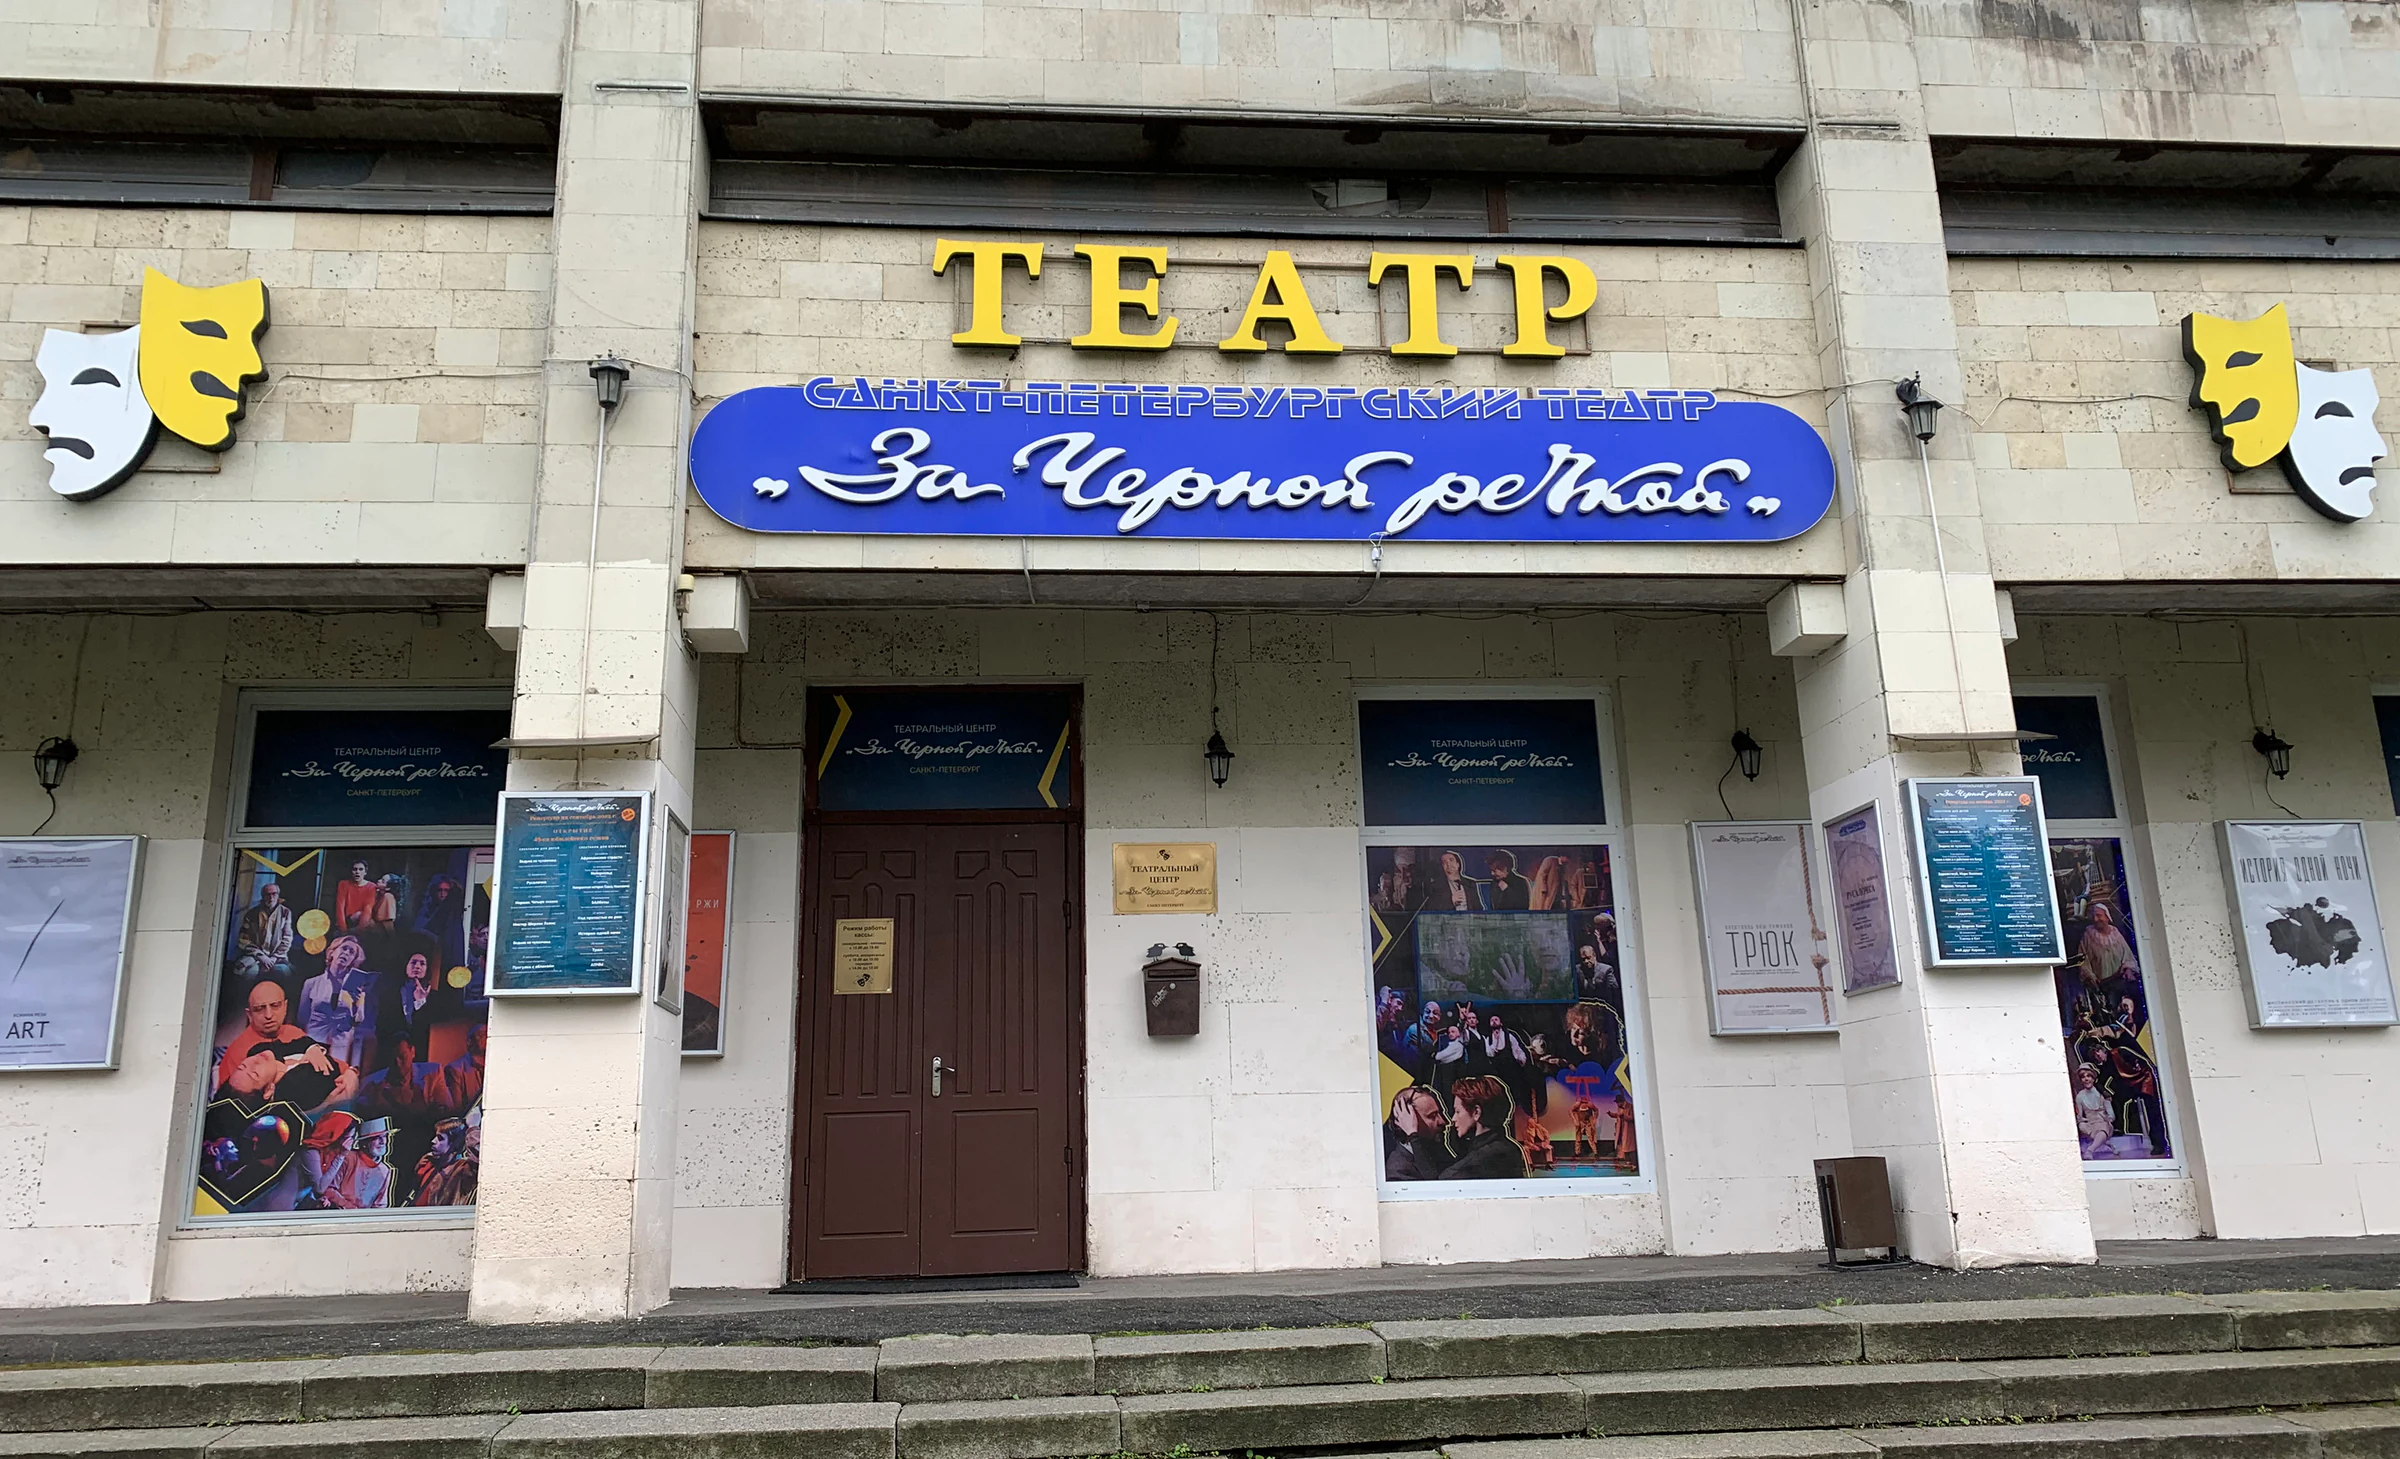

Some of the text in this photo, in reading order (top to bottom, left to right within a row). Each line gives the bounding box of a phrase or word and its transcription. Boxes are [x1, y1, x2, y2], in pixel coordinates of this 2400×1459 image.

[932, 238, 1598, 360] ТЕАТР
[1538, 387, 1718, 421] ТЕАТР
[1012, 430, 1414, 534] Черной
[893, 722, 997, 735] ТЕАТРАЛЬНЫЙ ЦЕНТР
[333, 745, 442, 757] ТЕАТРАЛЬНЫЙ ЦЕНТР
[894, 738, 973, 760] Черной
[1430, 738, 1528, 749] ТЕАТРАЛЬНЫЙ ЦЕНТР
[332, 760, 415, 783] Черной
[909, 765, 982, 775] САНКТ-ПЕТЕРБУРГ
[1432, 752, 1506, 772] Черной
[1447, 777, 1516, 786] САНКТ-ПЕТЕРБУРГ
[346, 788, 423, 797] САНКТ-ПЕТЕРБУРГ
[1130, 864, 1199, 873] ТЕАТРАЛЬНЫЙ
[2239, 854, 2362, 884] ИСТОРИЯ ОДНОЙ НОЧИ
[1149, 876, 1180, 884] ЦЕНТР
[1725, 930, 1800, 969] ТРЮК
[5, 1020, 50, 1039] ART
